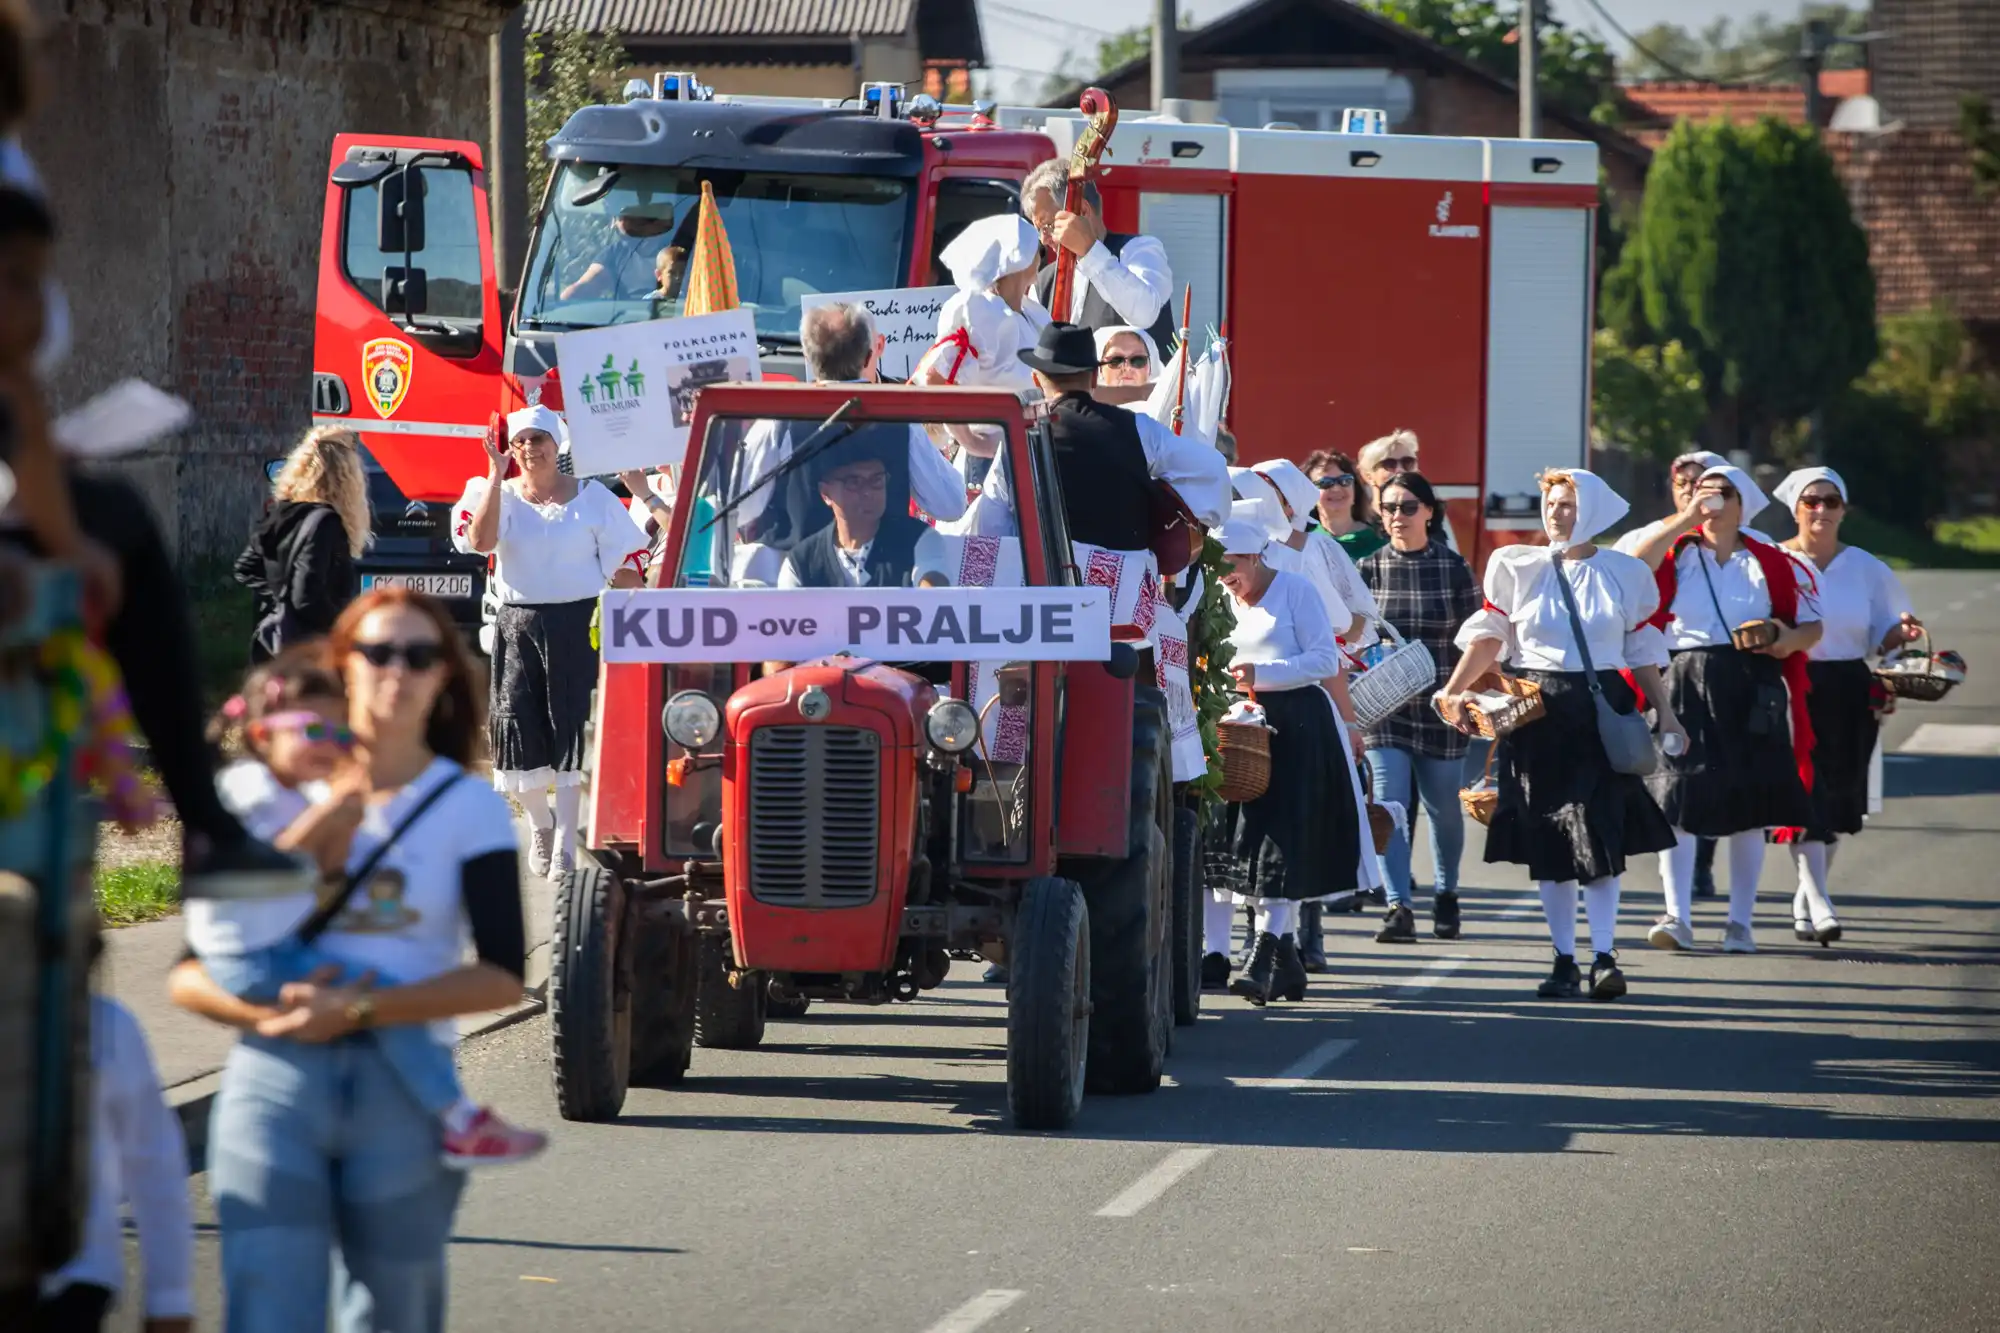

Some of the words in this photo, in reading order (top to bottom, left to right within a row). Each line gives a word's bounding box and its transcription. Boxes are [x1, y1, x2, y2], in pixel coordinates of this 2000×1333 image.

[664, 331, 747, 350] FOLKLORNA
[677, 346, 737, 361] SEKCIJA
[612, 607, 738, 648] KUD
[748, 617, 818, 636] -ove
[847, 603, 1075, 645] PRALJE
